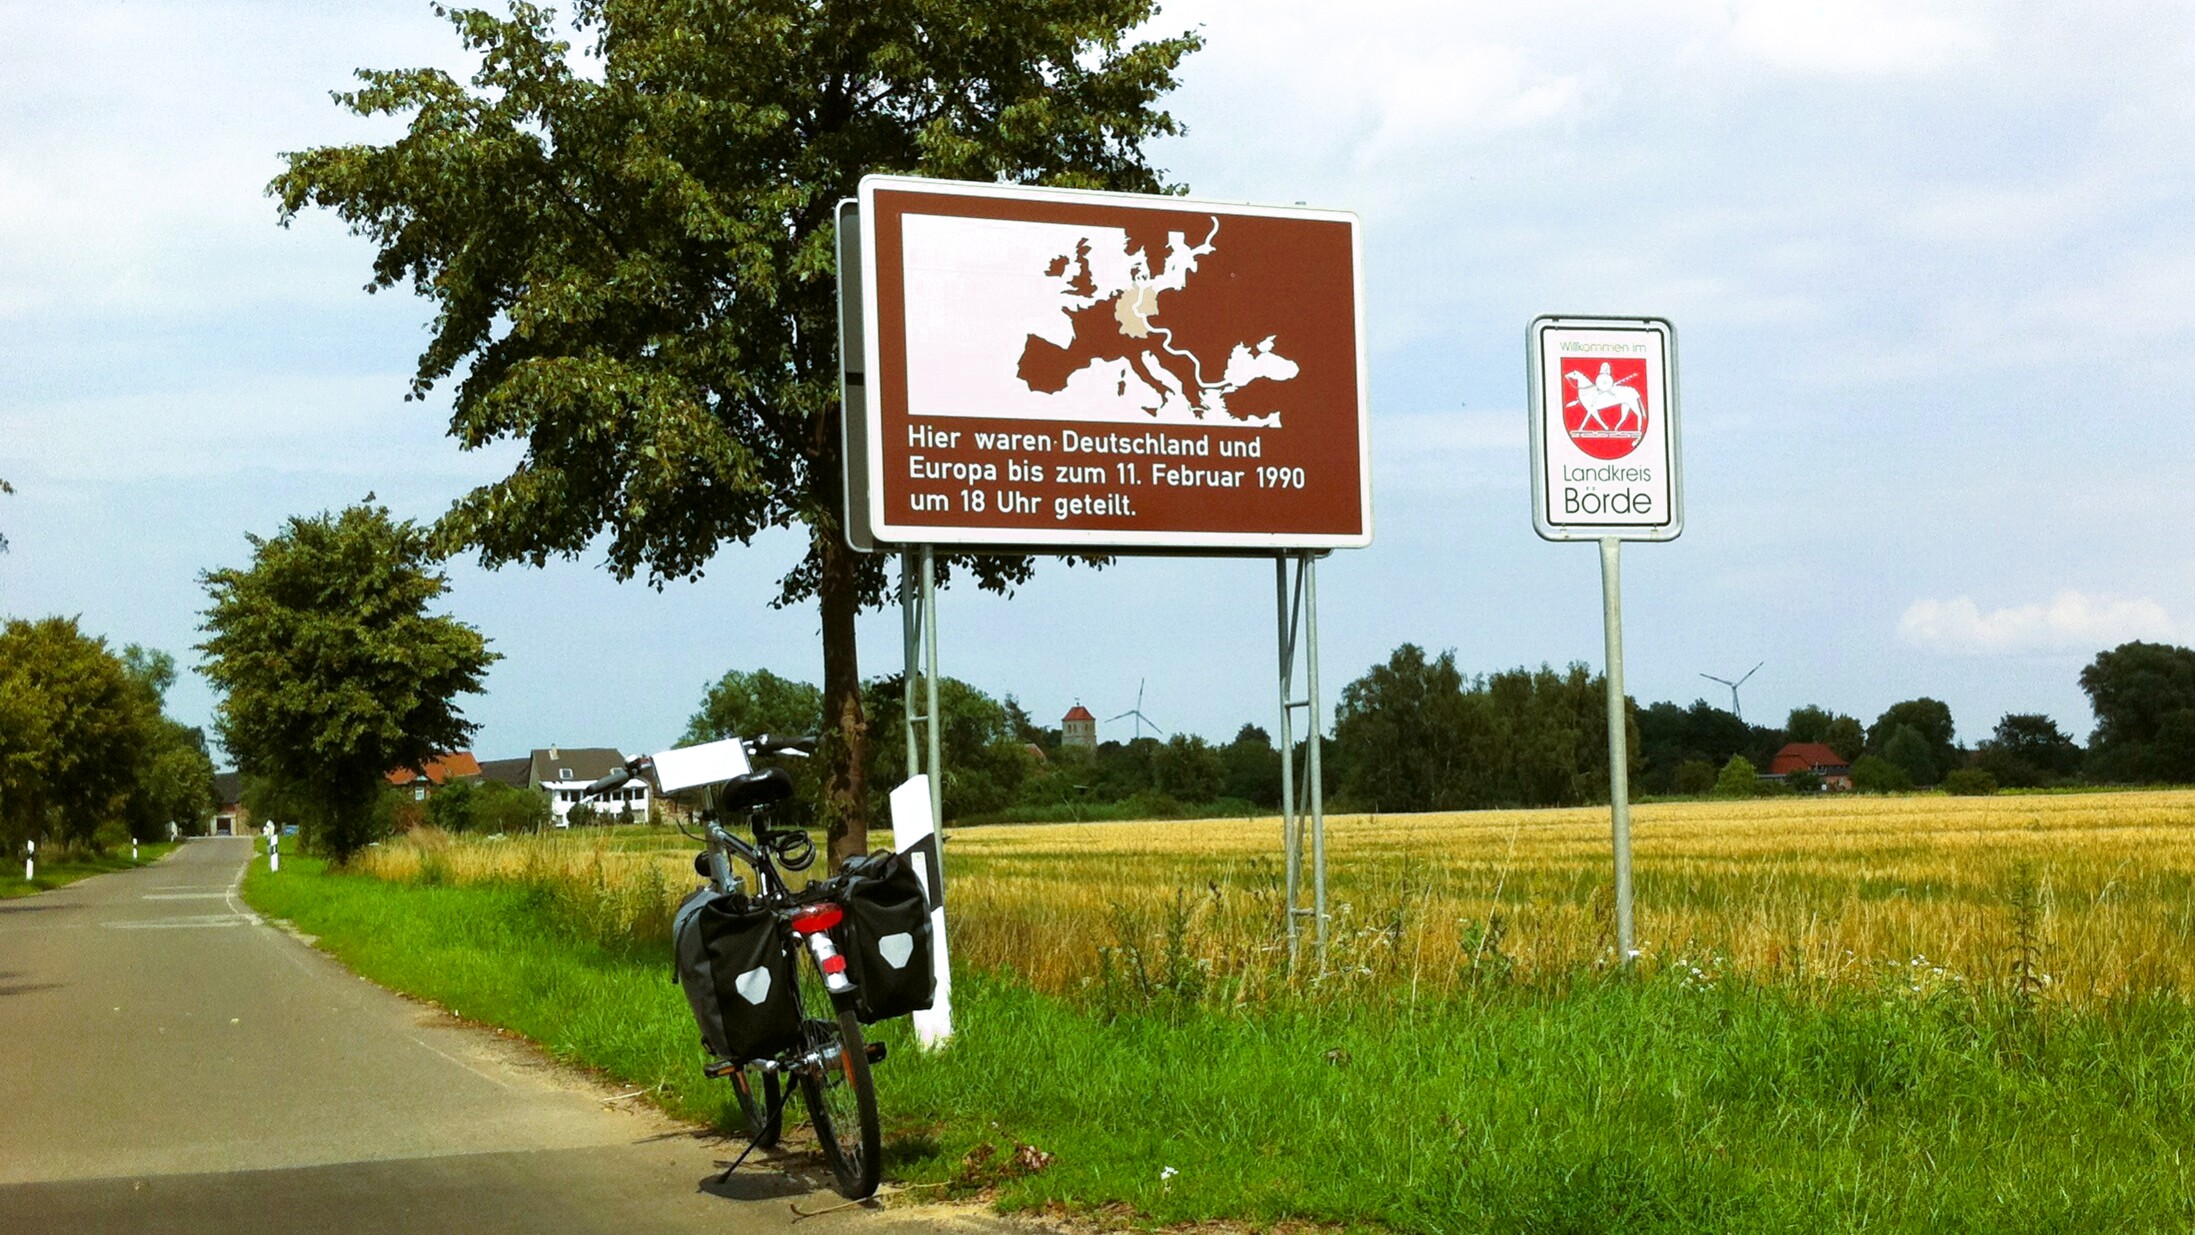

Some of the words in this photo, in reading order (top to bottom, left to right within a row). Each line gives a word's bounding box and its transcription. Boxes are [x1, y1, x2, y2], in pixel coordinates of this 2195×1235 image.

[1560, 341, 1629, 352] Willkommen
[1632, 342, 1647, 352] im
[908, 425, 961, 450] Hier
[975, 431, 1052, 452] waren
[1062, 430, 1209, 456] Deutschland
[1219, 436, 1262, 458] und
[909, 455, 998, 485] Europa
[1008, 459, 1044, 483] bis
[1056, 465, 1106, 485] zum
[1116, 462, 1142, 486] 11.
[1152, 463, 1246, 488] Februar
[1256, 466, 1306, 490] 1990
[1563, 464, 1652, 482] Landkreis
[910, 492, 949, 512] um
[960, 489, 986, 513] 18
[998, 490, 1042, 514] Uhr
[1054, 492, 1137, 521] geteilt.
[1564, 486, 1652, 515] Börde
